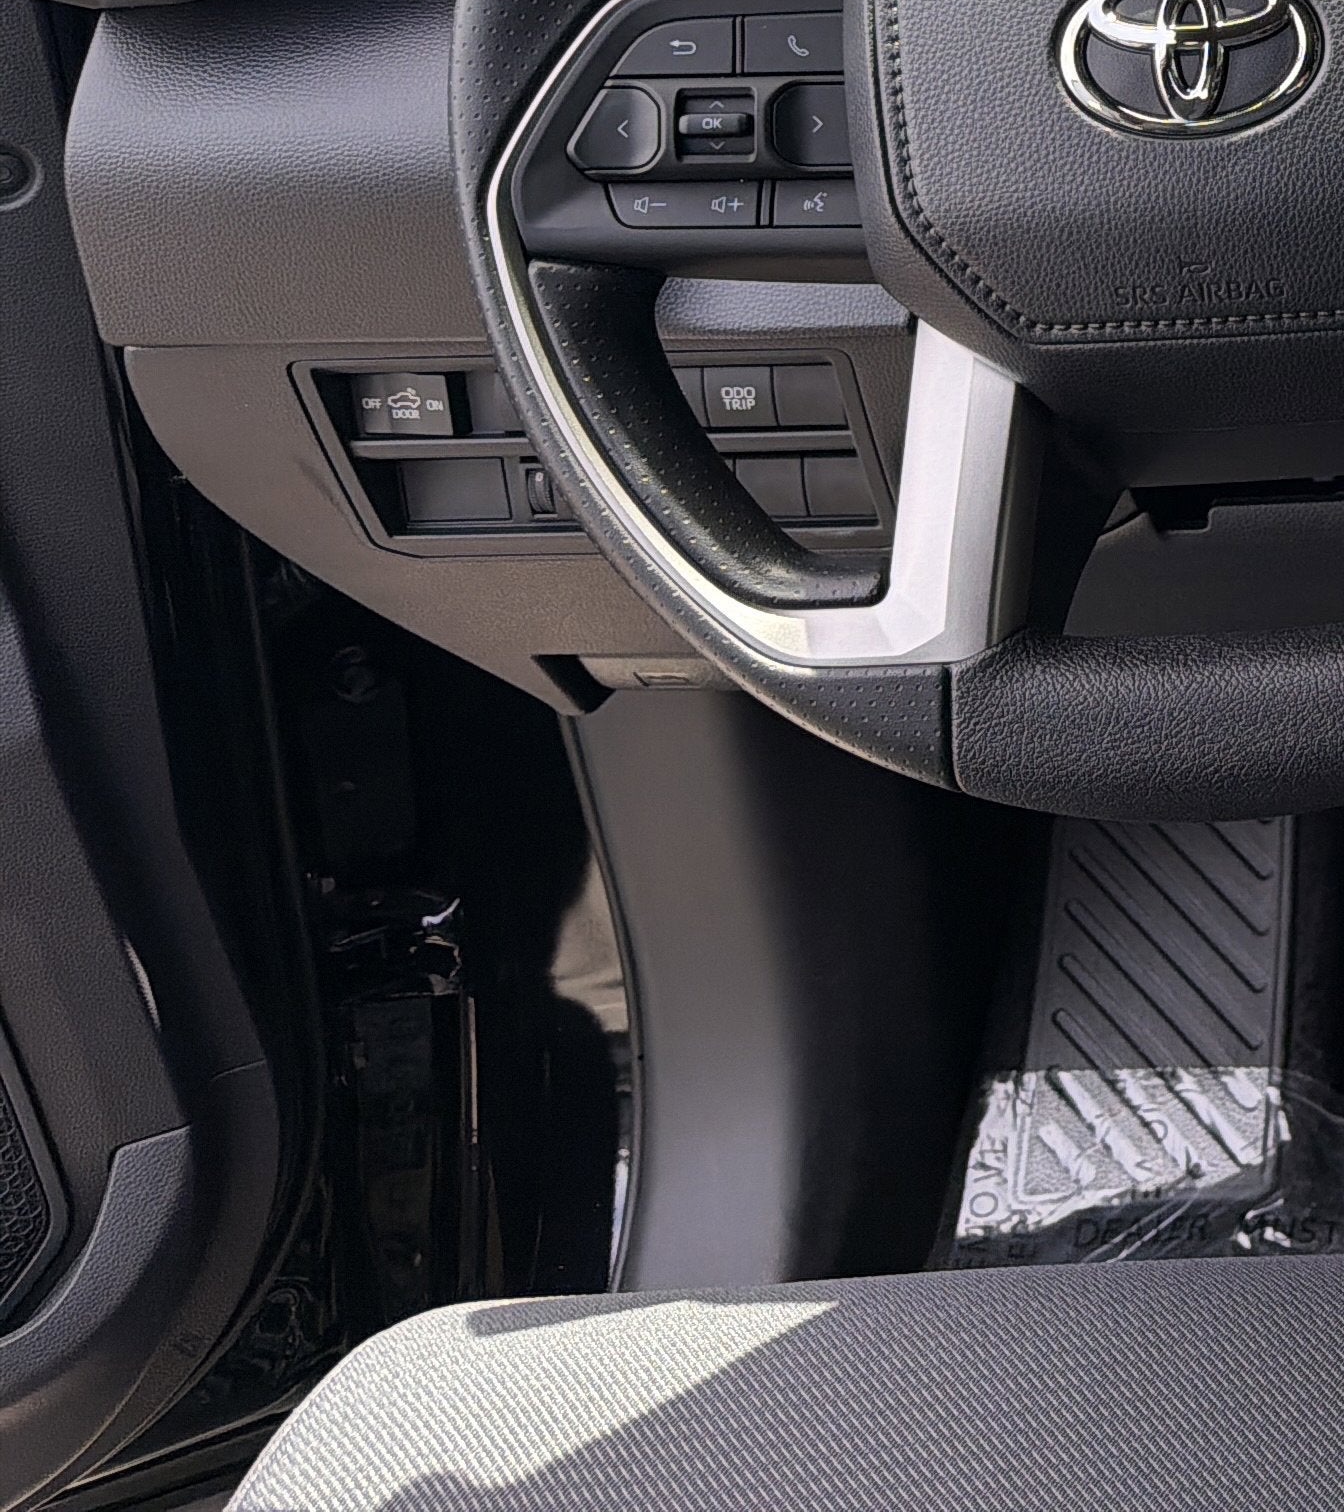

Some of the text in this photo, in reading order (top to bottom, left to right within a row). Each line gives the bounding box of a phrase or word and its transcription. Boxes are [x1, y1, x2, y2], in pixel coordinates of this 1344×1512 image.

[702, 117, 723, 130] OK
[1114, 280, 1288, 308] SRS AIRBAG
[721, 386, 756, 399] ODO
[362, 397, 444, 411] OFF ON
[723, 398, 756, 411] TRIP
[392, 409, 420, 419] DOOR
